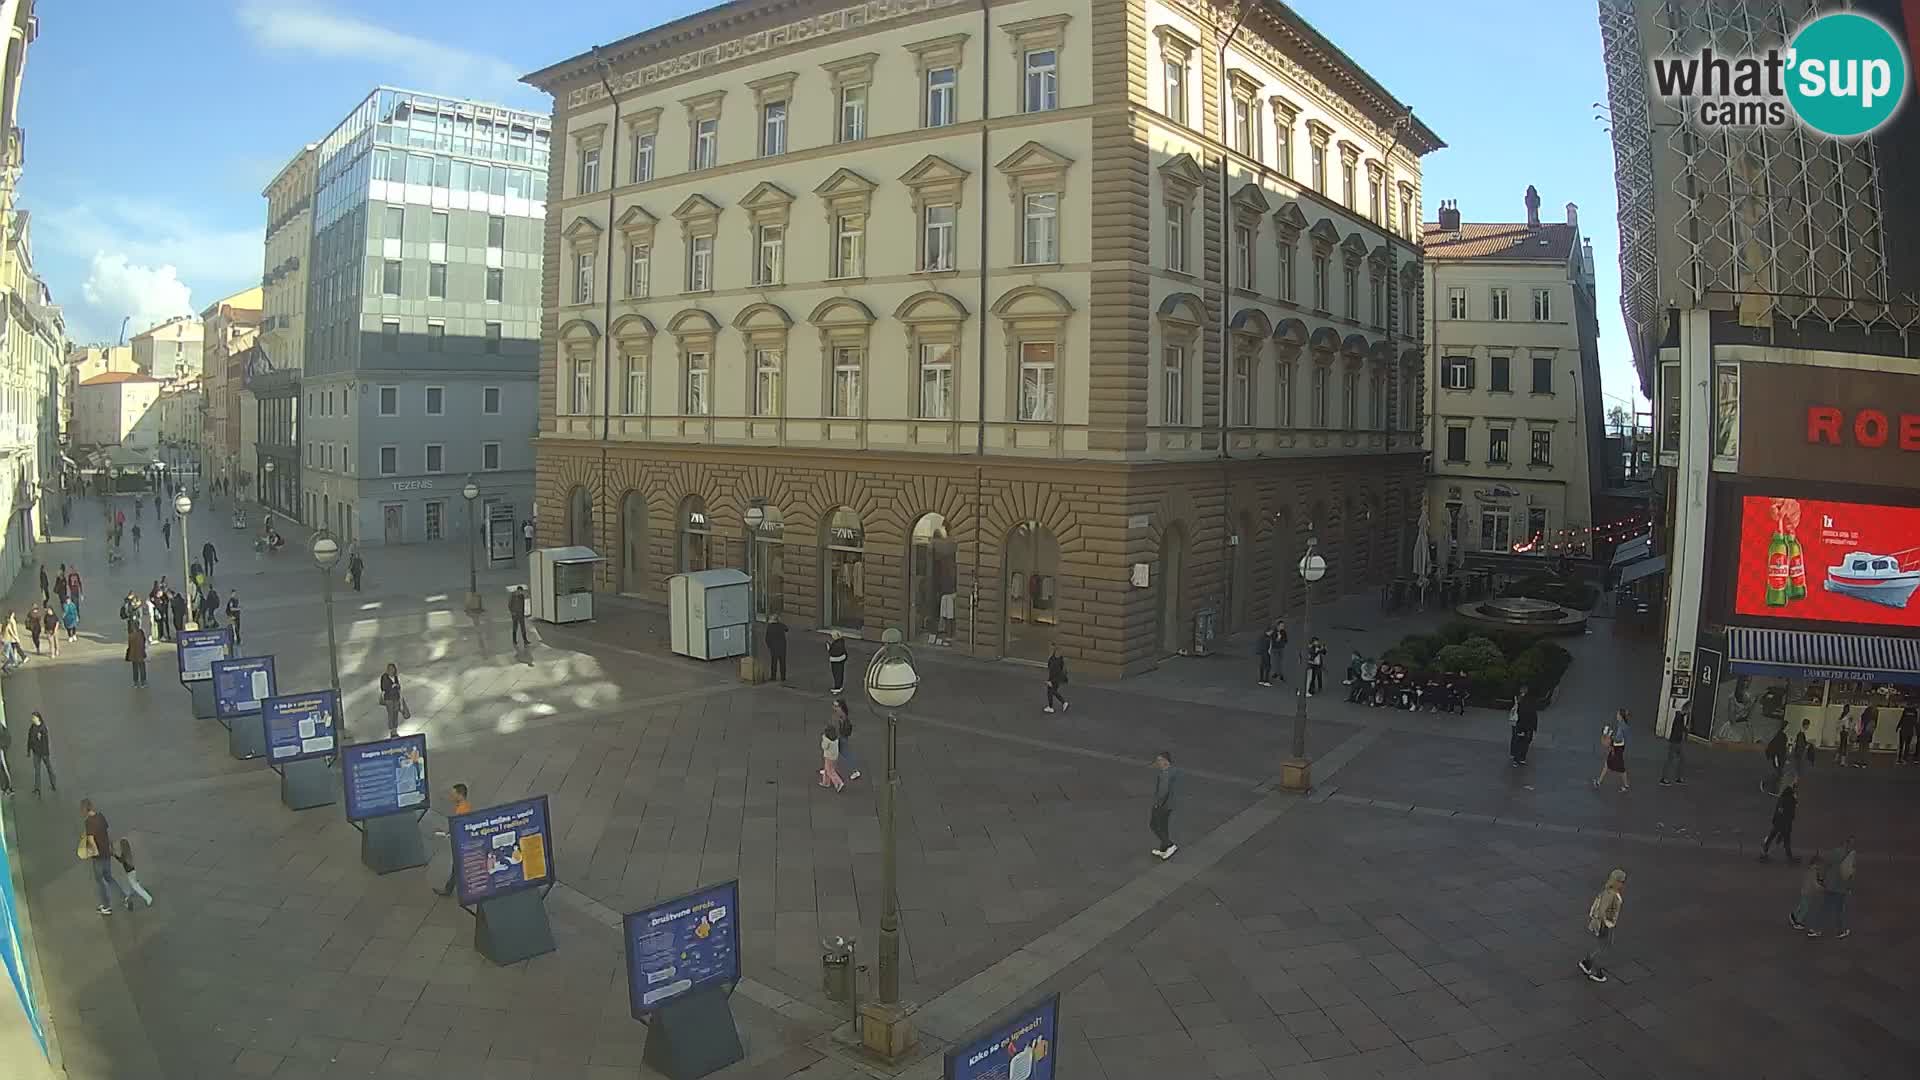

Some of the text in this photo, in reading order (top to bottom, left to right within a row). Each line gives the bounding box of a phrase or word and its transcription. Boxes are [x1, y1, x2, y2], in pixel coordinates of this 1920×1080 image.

[391, 479, 433, 491] TEZENIS
[1850, 671, 1875, 681] GELATO
[968, 1049, 989, 1067] Kako
